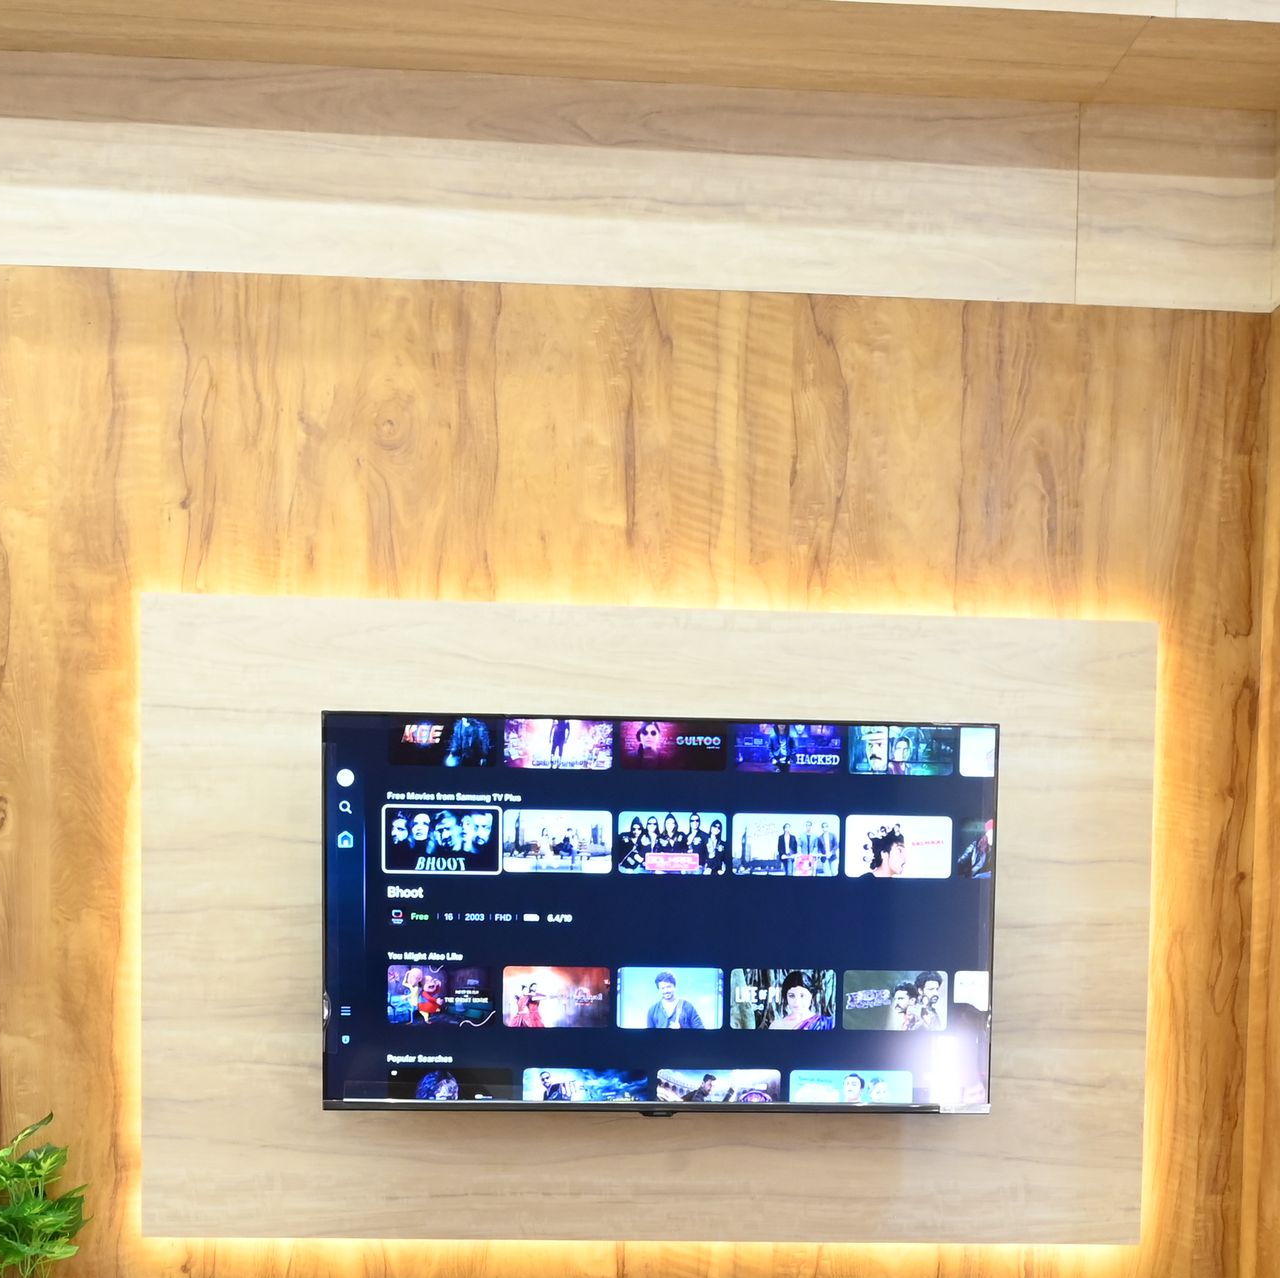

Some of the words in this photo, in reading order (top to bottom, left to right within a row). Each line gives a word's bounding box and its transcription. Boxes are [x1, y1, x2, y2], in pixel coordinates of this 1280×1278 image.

[795, 753, 841, 766] HACKED
[386, 791, 406, 800] Free
[406, 792, 435, 801] Movies
[436, 793, 456, 801] from
[456, 793, 492, 803] Samsung
[492, 793, 504, 801] TV
[504, 794, 522, 802] Plus
[414, 856, 466, 871] BHOOT
[387, 885, 424, 899] Bhoot
[410, 912, 430, 921] Free
[464, 913, 485, 922] 2003
[494, 914, 513, 922] FHD
[387, 951, 403, 960] You
[404, 951, 427, 962] Might
[428, 952, 444, 961] Also
[445, 952, 464, 961] Like
[386, 1054, 417, 1064] Popular
[417, 1054, 454, 1064] Searches
